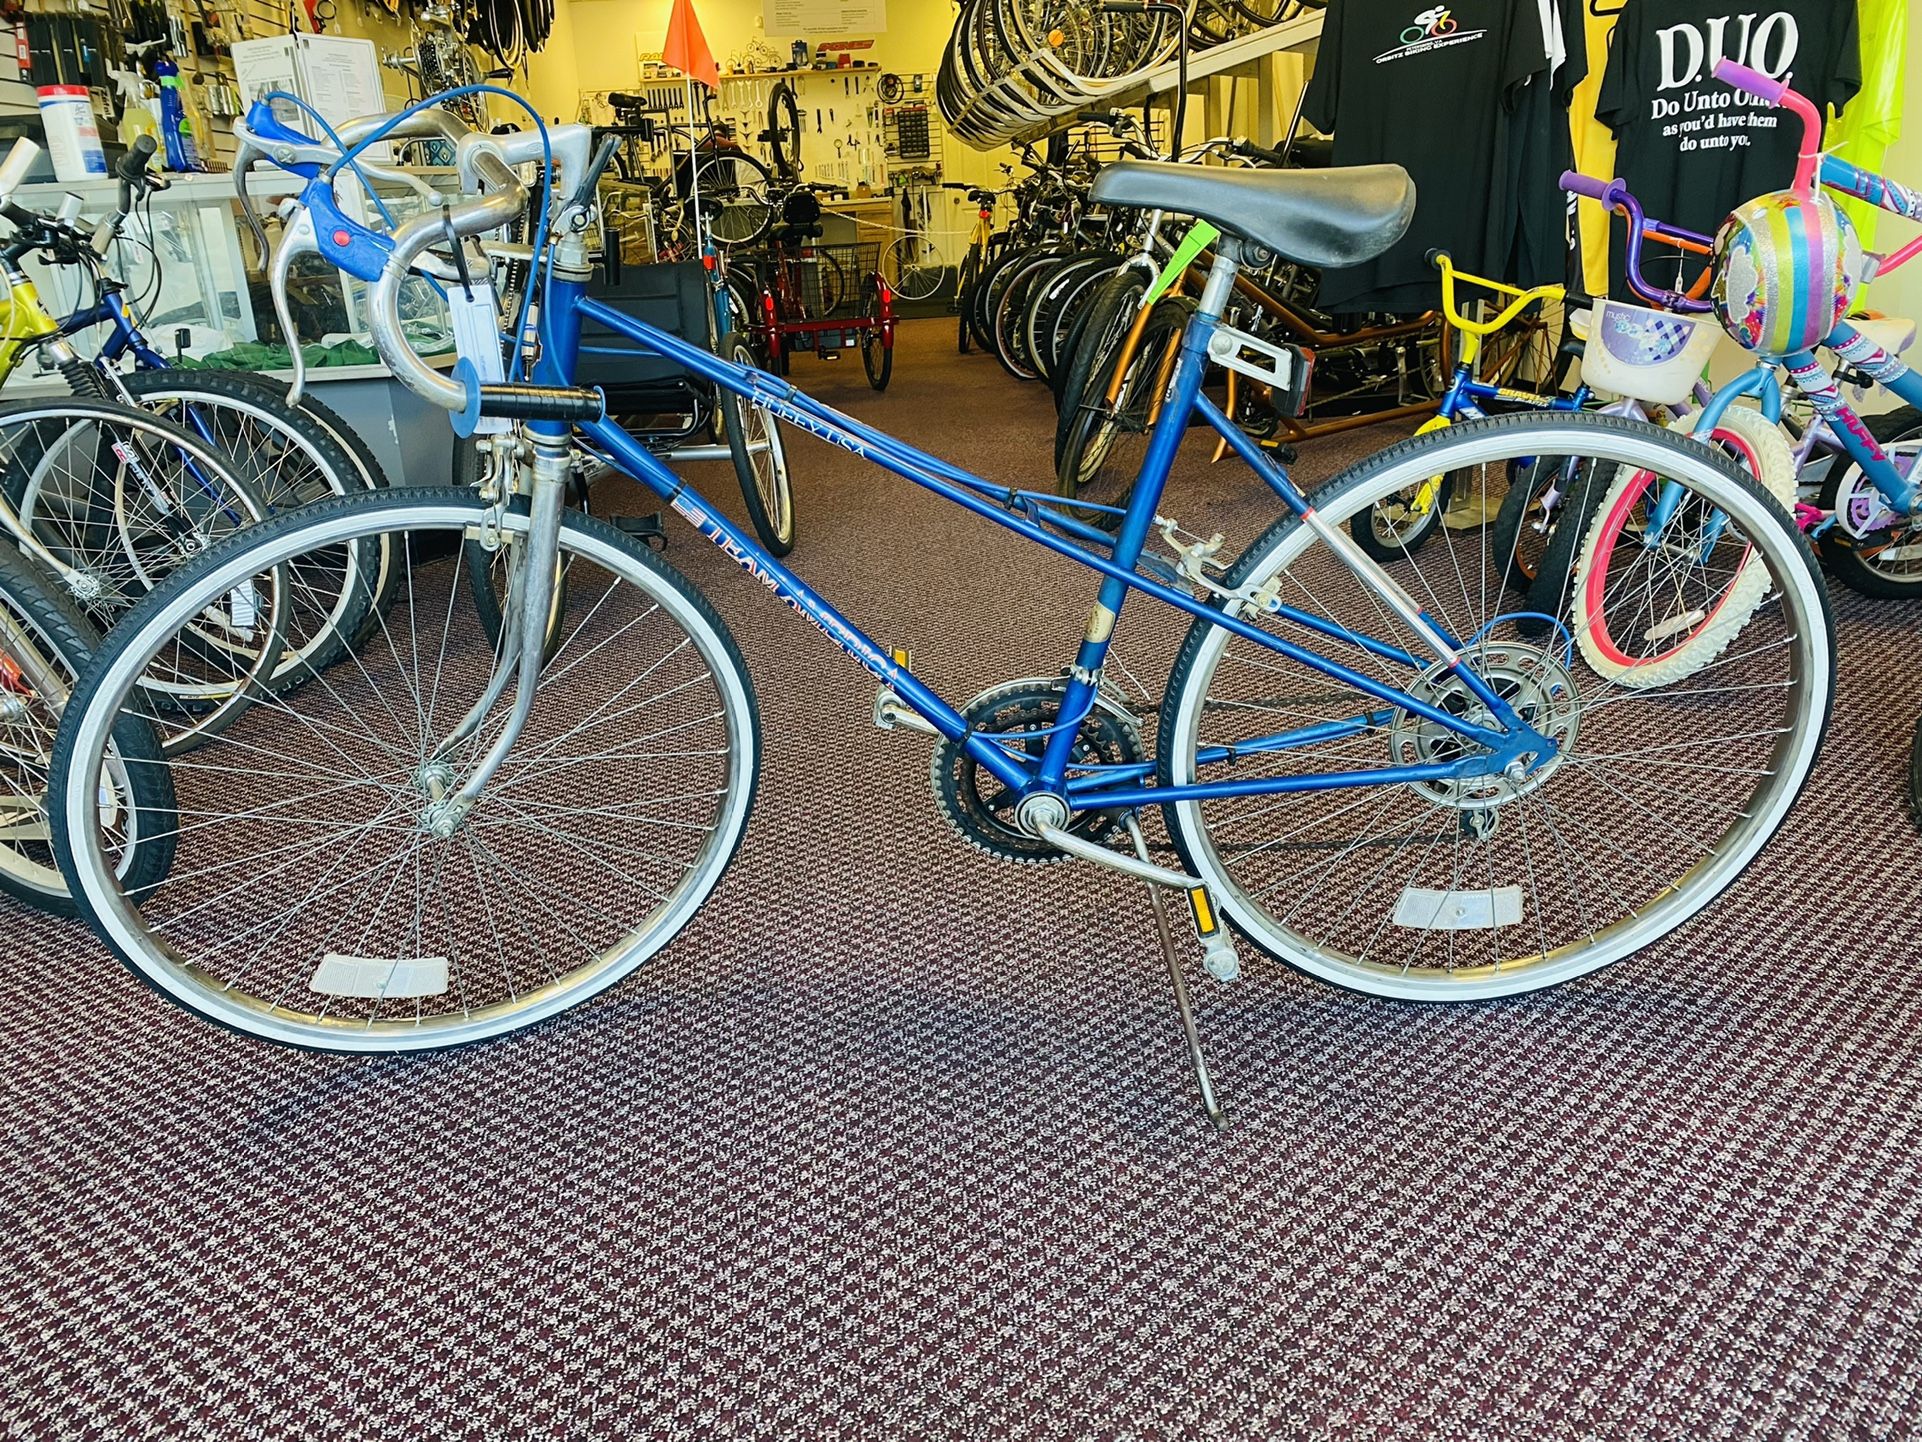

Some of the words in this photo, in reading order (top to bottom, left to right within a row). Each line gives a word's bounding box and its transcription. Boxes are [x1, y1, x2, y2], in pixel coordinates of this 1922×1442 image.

[1376, 52, 1404, 64] ORBITZ
[1404, 46, 1432, 57] BIKING
[1433, 32, 1483, 49] EXPERIENCE
[1651, 98, 1680, 119] Do
[1684, 90, 1731, 112] Unto
[1663, 124, 1678, 136] as
[1678, 115, 1715, 137] you'd
[1718, 112, 1746, 128] have
[1679, 137, 1697, 151] do
[1700, 134, 1730, 149] unto
[752, 390, 822, 432] HUFFY
[826, 429, 865, 458] USA
[1835, 406, 1887, 461] HUFFY
[707, 523, 786, 593] TEAM
[780, 589, 899, 692] AMERICA
